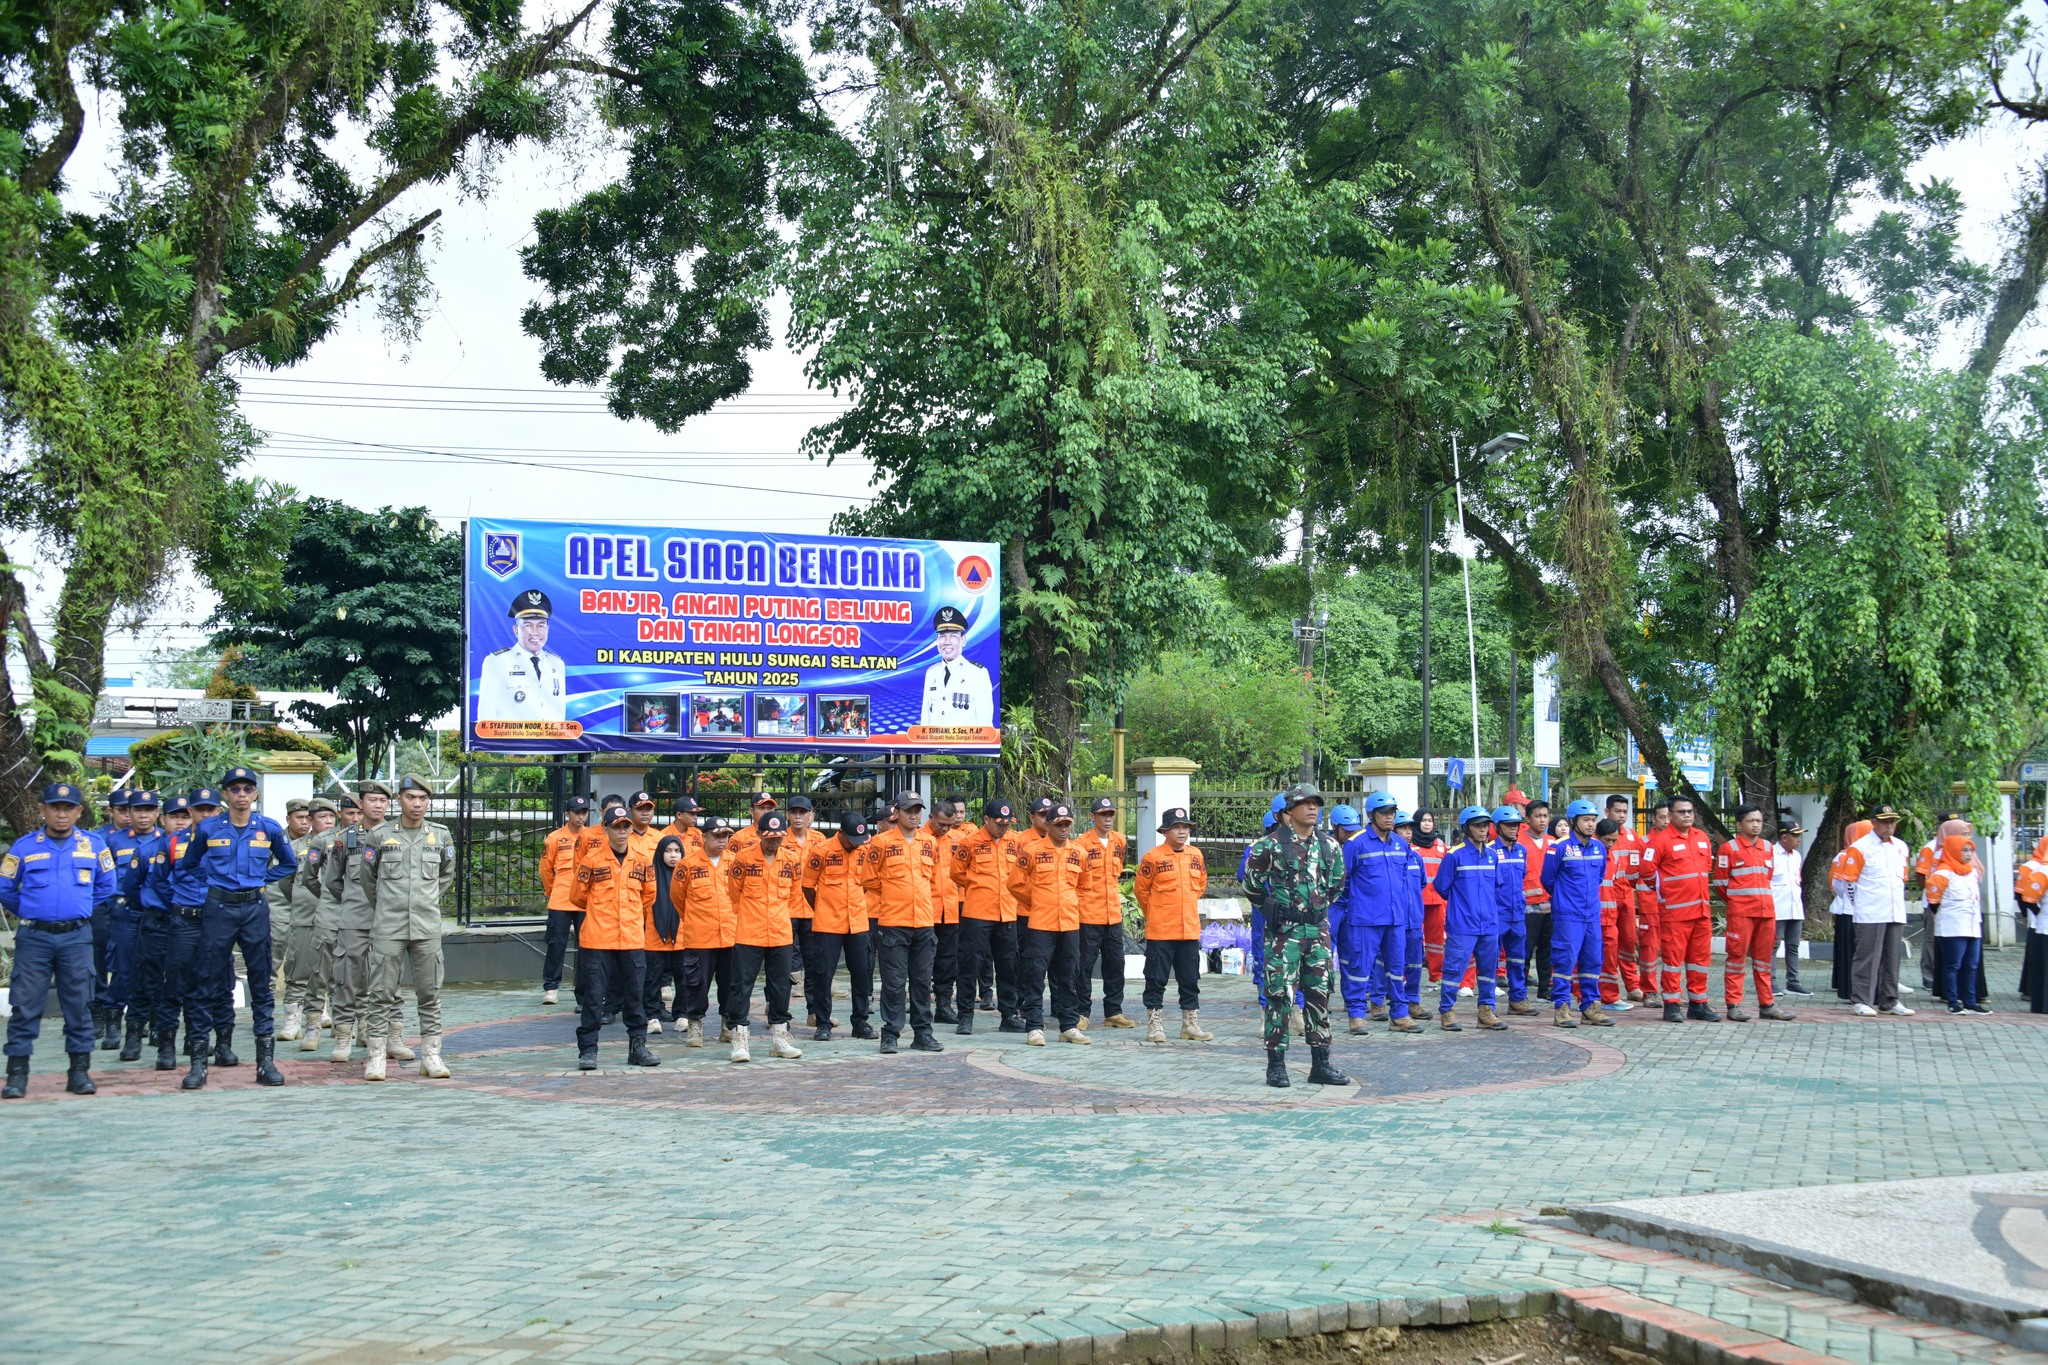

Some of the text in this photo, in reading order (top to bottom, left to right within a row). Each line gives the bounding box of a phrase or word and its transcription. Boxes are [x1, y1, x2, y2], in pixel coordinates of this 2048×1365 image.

[569, 536, 922, 589] APEL SIAGA BENCANA
[582, 591, 911, 622] BANJIR, ANGIN PUTING BELIUNG
[639, 620, 859, 647] DAN TANAH LONGSOR
[597, 649, 897, 670] DI KABUPATEN HULU SUNGAI SELATAN
[704, 671, 799, 686] TAHUN 2025
[524, 723, 543, 731] NOOR,
[929, 727, 951, 735] SURIANI,
